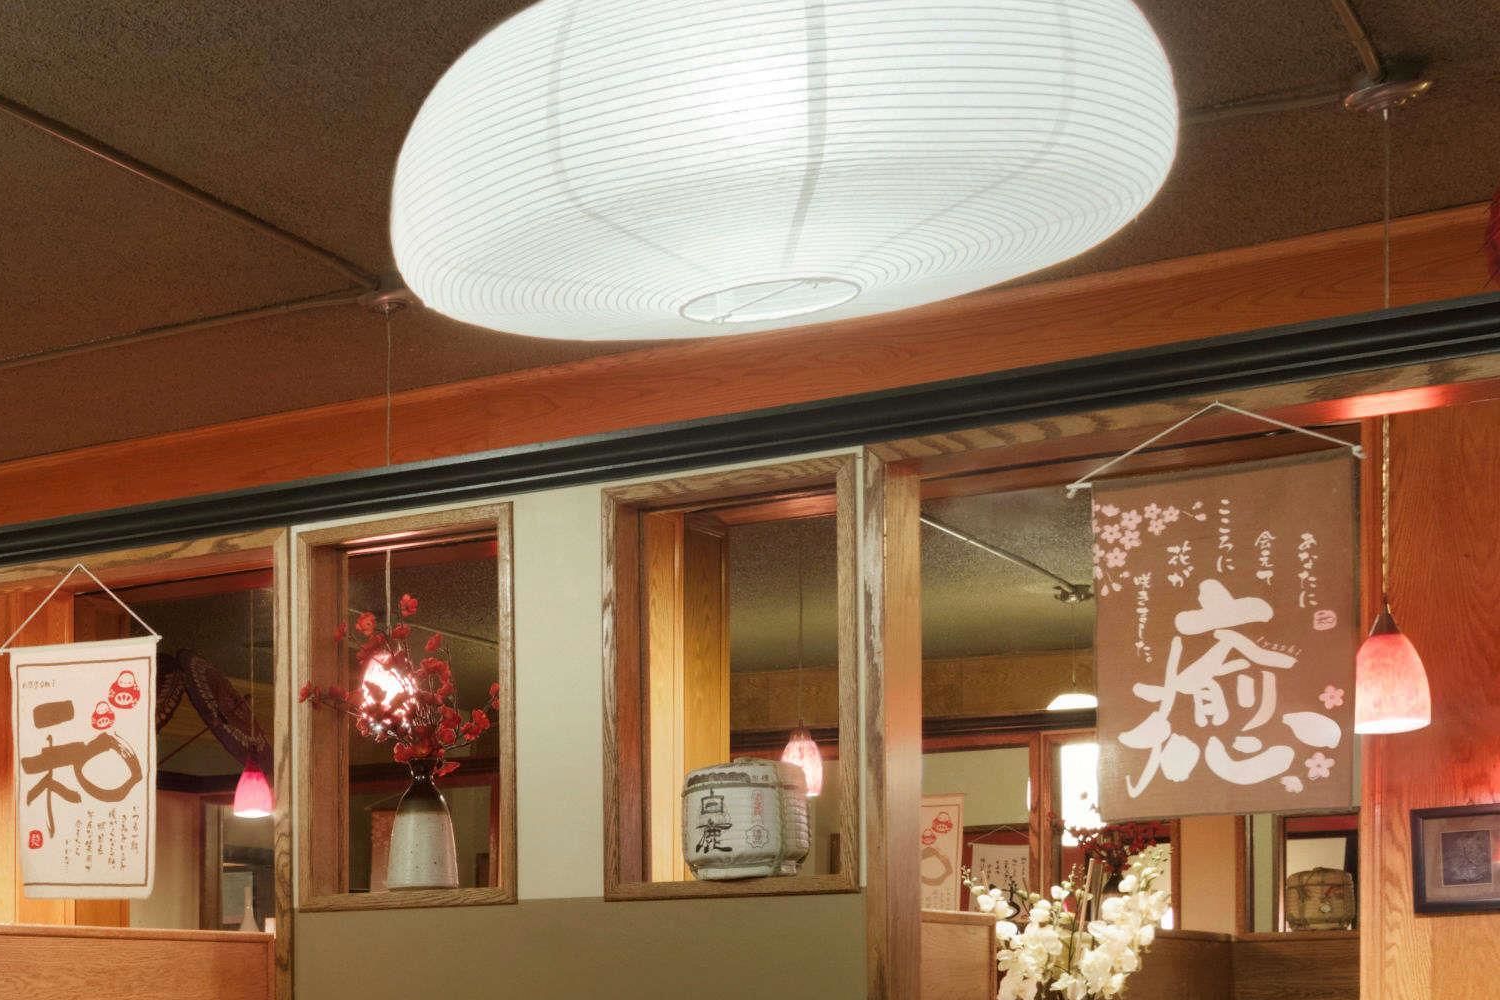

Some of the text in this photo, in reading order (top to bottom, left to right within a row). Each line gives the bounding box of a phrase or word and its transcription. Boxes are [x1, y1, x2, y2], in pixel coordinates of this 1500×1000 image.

[1215, 499, 1235, 573] こころに
[1117, 578, 1343, 799] 癒
[21, 700, 143, 838] 和
